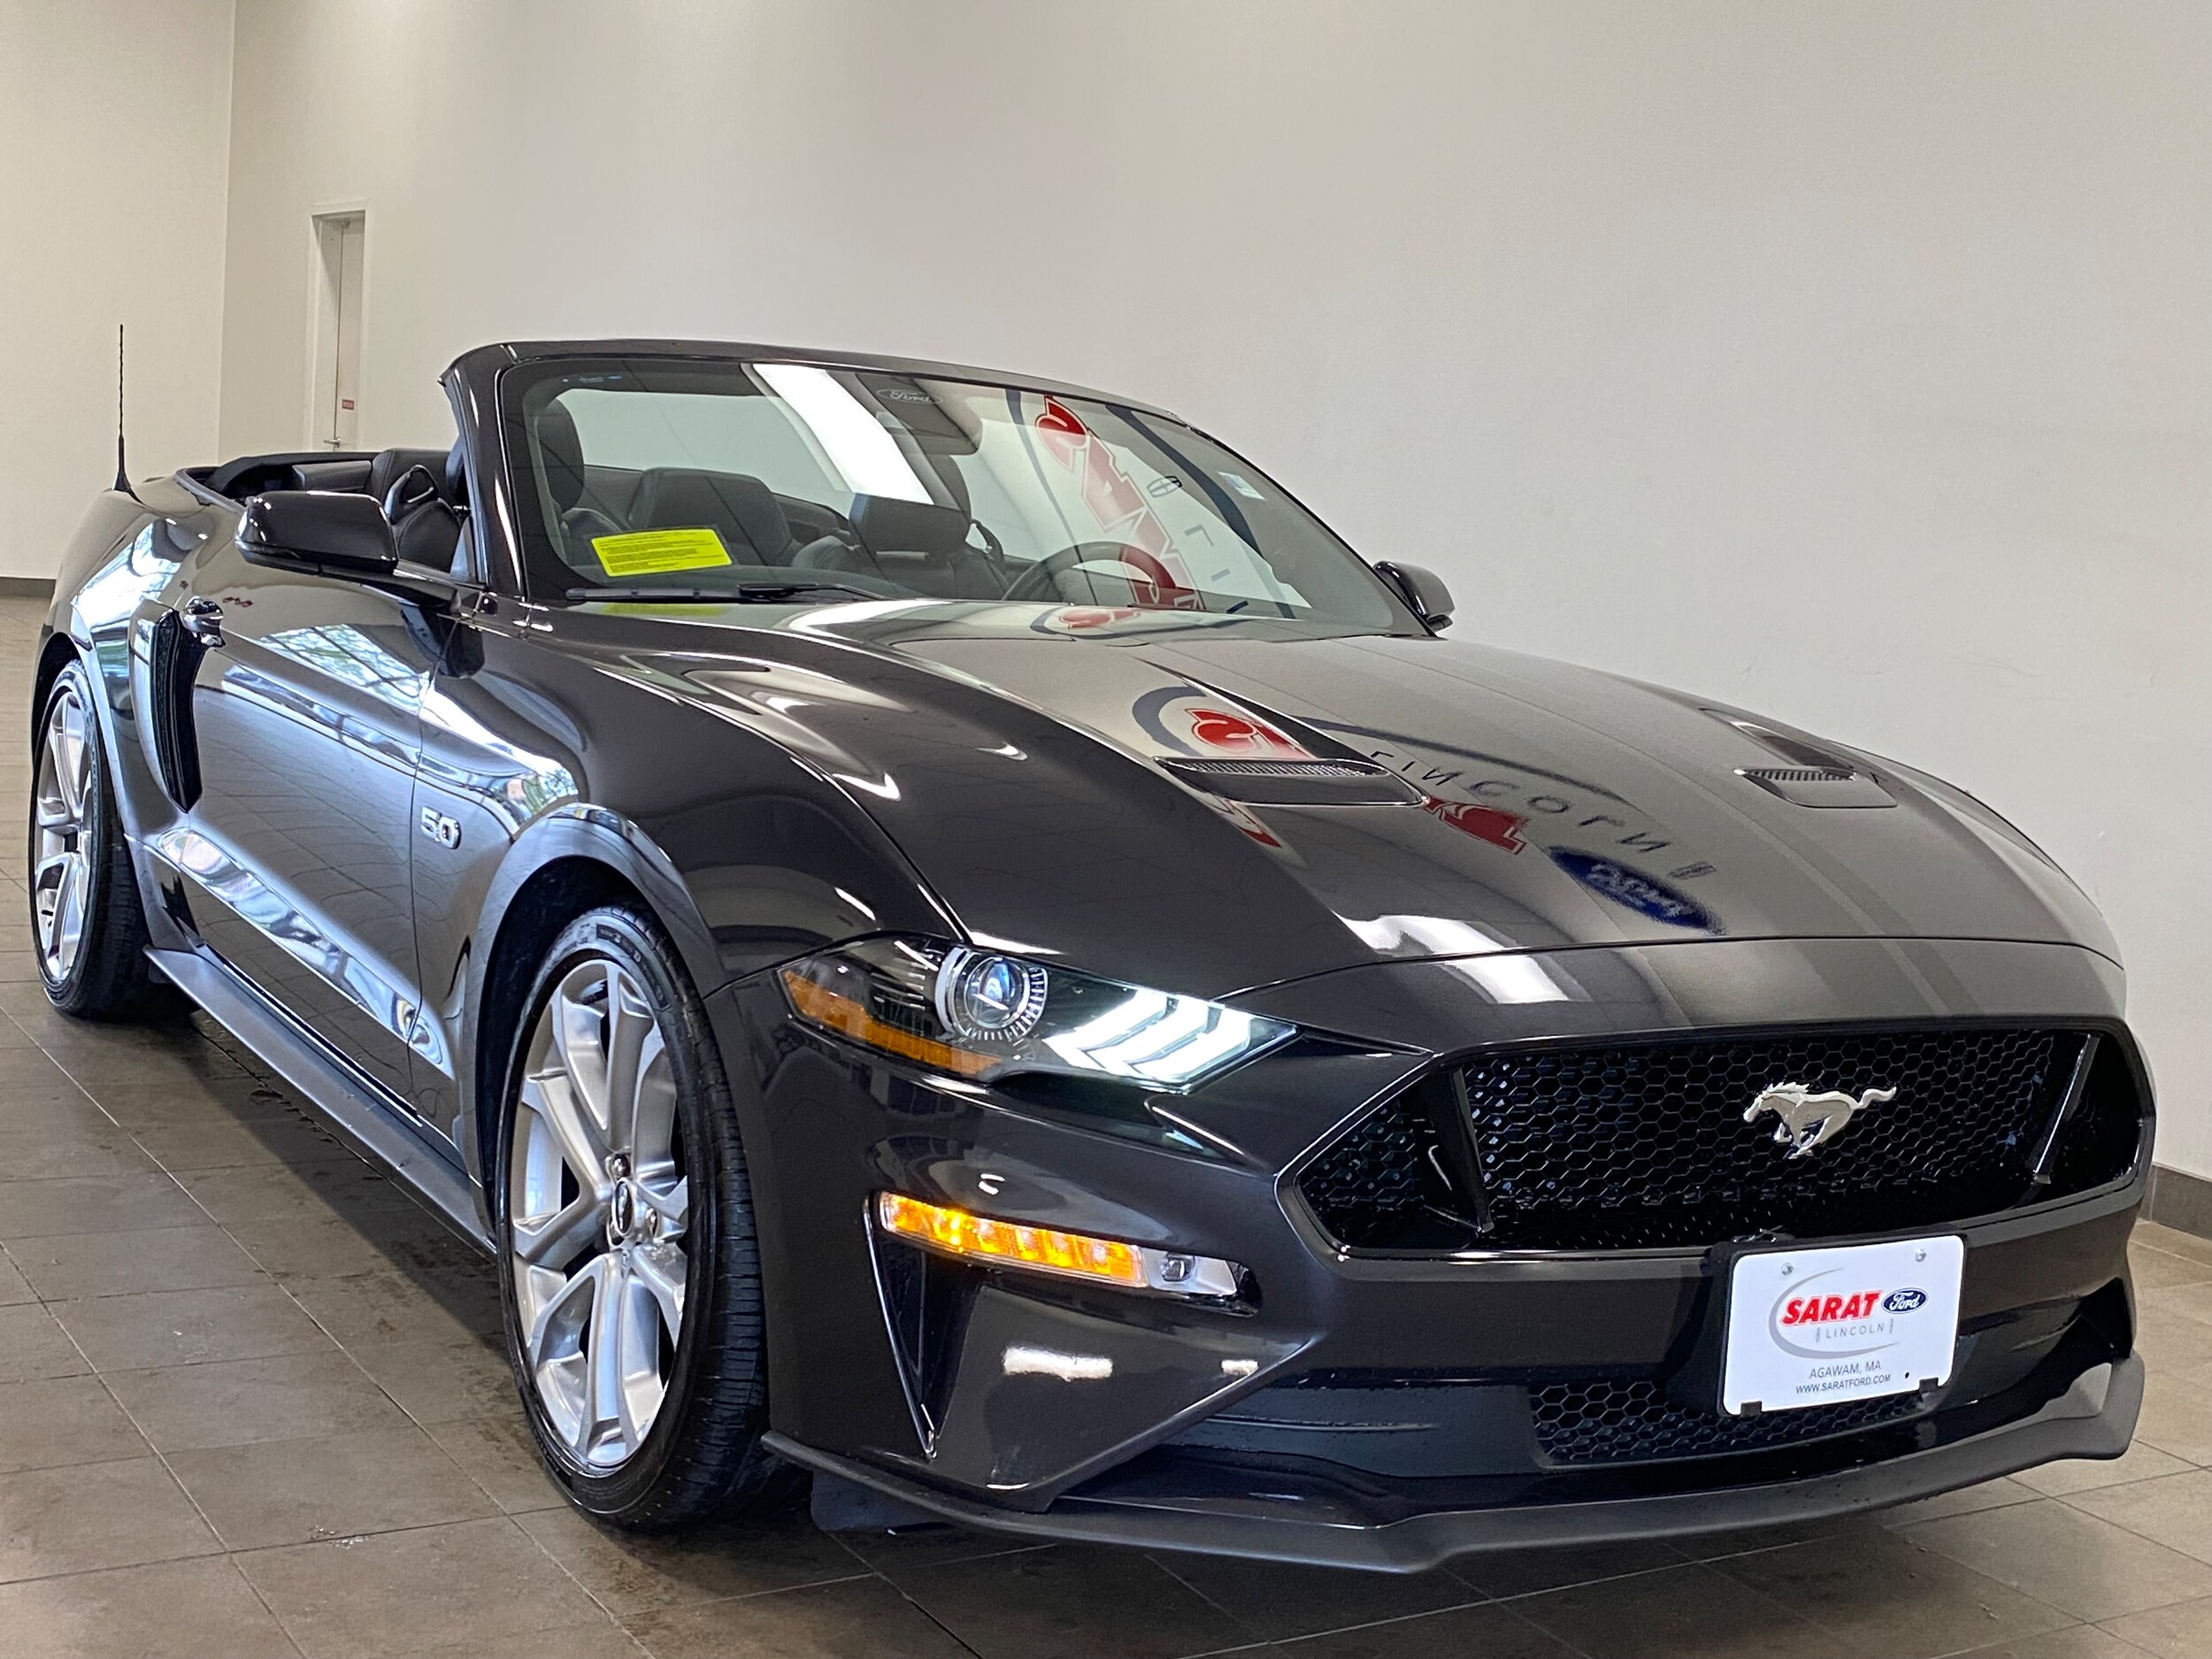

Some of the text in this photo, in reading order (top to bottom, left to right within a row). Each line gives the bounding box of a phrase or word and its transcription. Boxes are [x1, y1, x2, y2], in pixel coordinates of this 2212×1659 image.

[1780, 1290, 1921, 1325] SARAT Ford
[1826, 1325, 1884, 1339] LINCOLN
[1809, 1360, 1882, 1379] AGAWAM, MA
[1796, 1374, 1890, 1394] WWW.SARATFORD.COM
